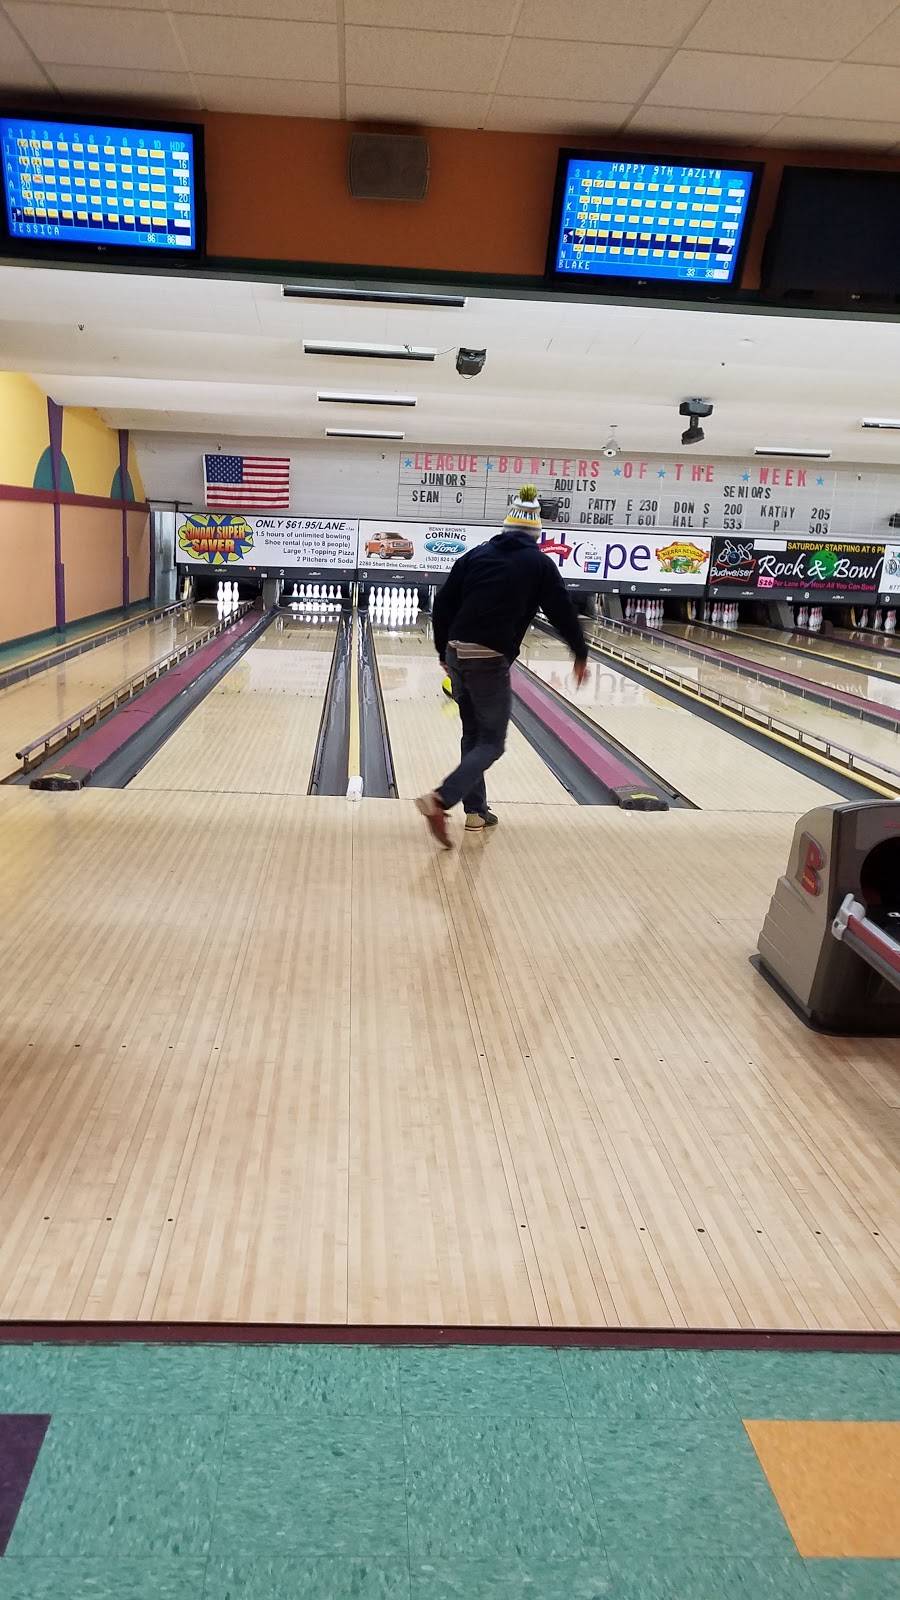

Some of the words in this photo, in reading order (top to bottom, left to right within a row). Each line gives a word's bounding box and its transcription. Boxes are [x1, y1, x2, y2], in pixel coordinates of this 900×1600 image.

[74, 133, 79, 143] 5
[106, 136, 111, 145] 7
[139, 139, 144, 148] 9
[154, 140, 161, 149] 10
[170, 141, 185, 151] HDP
[179, 160, 187, 168] 16
[612, 163, 645, 174] HAPPY
[653, 166, 673, 176] 9TH
[681, 168, 721, 179] JAZLYN
[179, 177, 187, 185] 16
[22, 181, 31, 190] 20
[178, 194, 188, 202] 20
[568, 185, 574, 194] H
[585, 186, 590, 195] 4
[566, 202, 572, 211] K
[180, 210, 188, 219] 14
[12, 223, 60, 235] JESSICA
[581, 220, 586, 228] 2
[559, 260, 590, 270] BLAKE
[723, 261, 728, 269] 0
[415, 453, 477, 472] LEAGUE
[498, 456, 600, 477] BOWLERS
[624, 461, 648, 479] OF
[674, 463, 714, 482] THE
[759, 467, 807, 487] WEEK
[421, 472, 466, 486] JUNIORS
[555, 479, 596, 492] ADULTS
[412, 490, 439, 503] SEAN
[456, 492, 462, 503] C
[723, 486, 771, 499] SENIORS
[588, 498, 616, 511] PATTY
[627, 499, 633, 511] E
[639, 500, 658, 512] 230
[673, 501, 695, 514] DON
[703, 503, 710, 514] S
[724, 504, 742, 515] 200
[760, 505, 795, 519] KATHY
[811, 507, 830, 520] 205
[255, 520, 283, 528] ONLY
[285, 520, 346, 530] $61.95/LANE
[580, 512, 614, 525] DEBBIE
[625, 514, 630, 525] T
[638, 514, 656, 526] 601
[673, 516, 694, 528] HAL
[703, 517, 709, 528] F
[723, 518, 742, 530] 533
[774, 520, 779, 531] P
[185, 526, 216, 540] SUNDAY
[217, 526, 245, 539] SUPER
[326, 533, 350, 541] bowling
[425, 531, 467, 541] CORNING
[192, 539, 235, 552] SAVER
[432, 541, 459, 552] Ford
[788, 543, 824, 551] SATURDAY
[710, 566, 754, 577] Budweiser
[758, 553, 806, 579] Rock
[807, 560, 826, 580] &
[833, 557, 884, 579] Bowl
